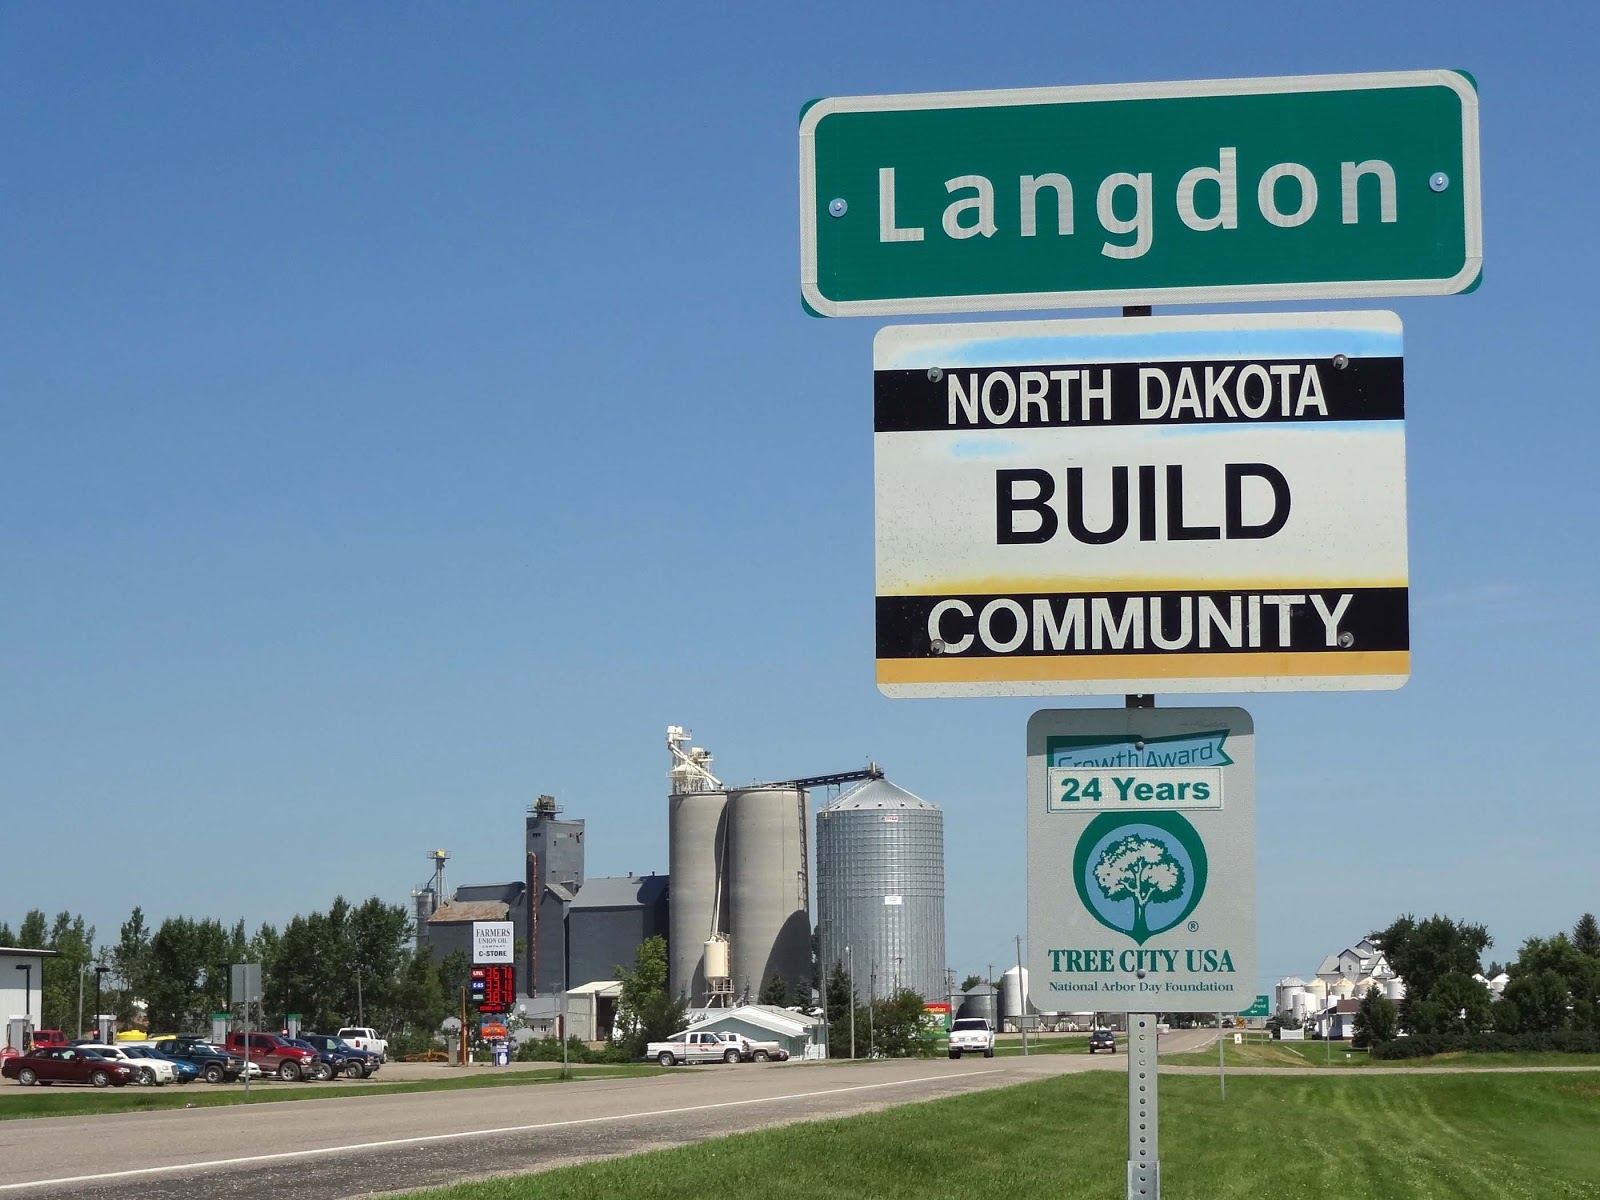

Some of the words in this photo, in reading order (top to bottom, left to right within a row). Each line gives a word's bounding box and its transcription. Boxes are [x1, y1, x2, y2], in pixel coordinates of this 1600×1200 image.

[878, 145, 1399, 260] Langdon
[947, 368, 1112, 425] NORTH
[1138, 363, 1329, 420] DAKOTA
[995, 462, 1292, 545] BUILD
[927, 593, 1354, 654] COMMUNITY
[1146, 741, 1213, 768] Award
[1060, 776, 1103, 802] 24
[1111, 776, 1211, 802] Years
[476, 928, 511, 937] FARMERS
[1048, 948, 1116, 973] TREE
[1119, 948, 1181, 973] CITY
[1186, 948, 1236, 973] USA
[1048, 980, 1099, 992] National
[1101, 980, 1137, 992] Arbor
[1139, 980, 1161, 994] Day
[1165, 980, 1234, 992] Foundation
